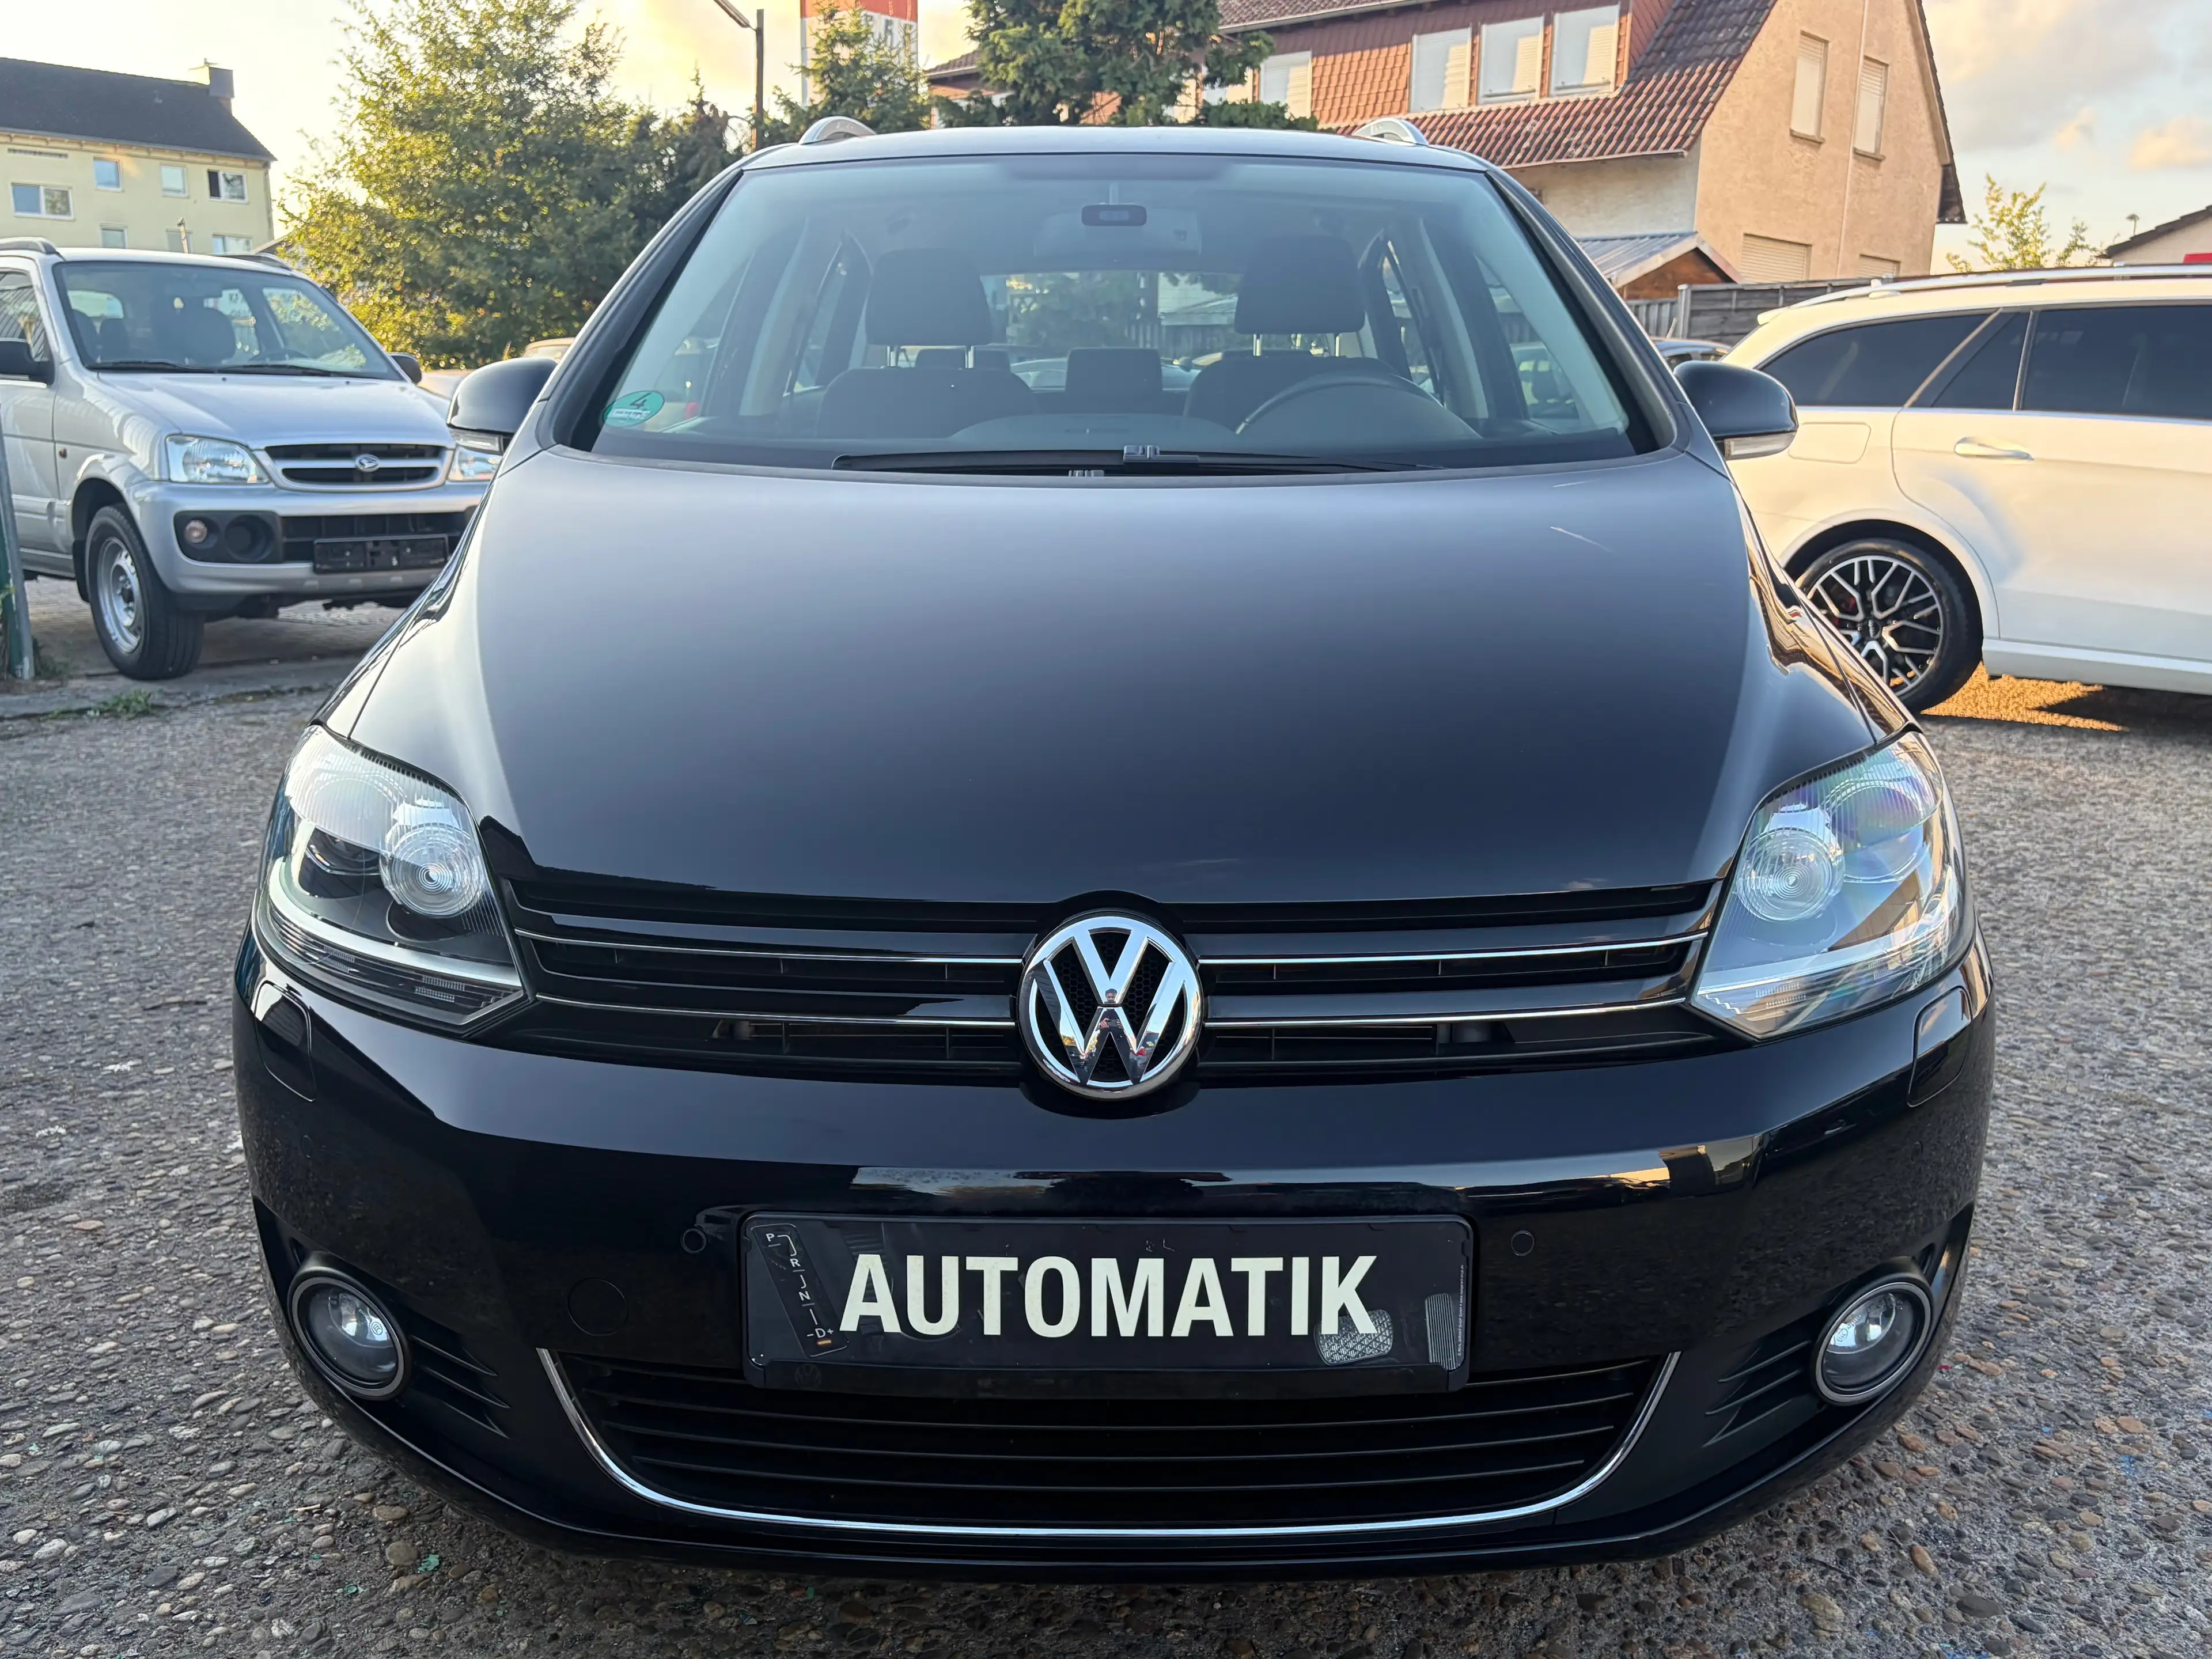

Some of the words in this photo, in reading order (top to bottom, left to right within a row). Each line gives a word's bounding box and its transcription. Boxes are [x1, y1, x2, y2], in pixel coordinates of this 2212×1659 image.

[629, 392, 652, 410] 4
[766, 1233, 775, 1242] P
[790, 1258, 801, 1267] R
[798, 1290, 810, 1301] N
[839, 1254, 1377, 1337] AUTOMATIK
